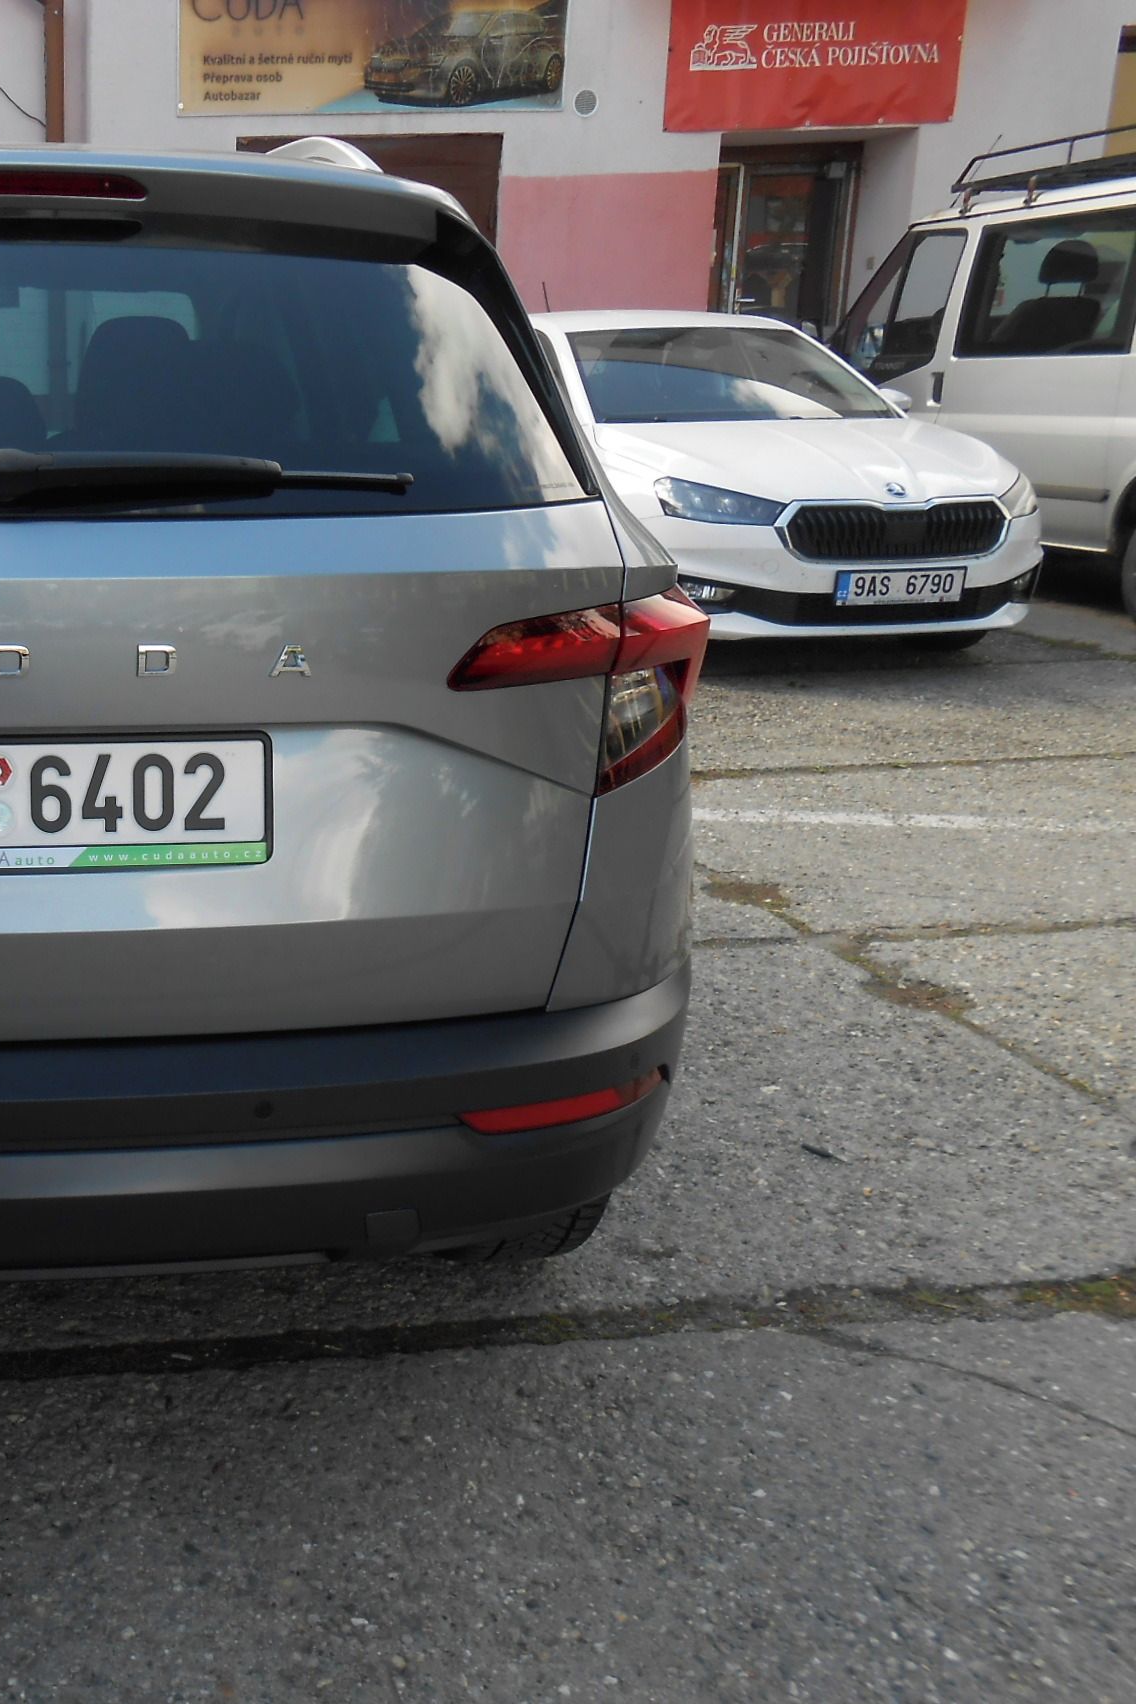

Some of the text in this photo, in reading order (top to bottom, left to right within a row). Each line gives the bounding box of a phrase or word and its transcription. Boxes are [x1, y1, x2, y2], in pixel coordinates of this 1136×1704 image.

[763, 21, 856, 43] GENERALI
[203, 53, 246, 65] Kvalitní
[248, 56, 256, 65] a
[258, 52, 294, 65] šetrné
[296, 52, 325, 65] ruční
[761, 41, 940, 69] ČESKÁ POJIŠŤOVNA
[203, 71, 283, 85] Přeprava osob
[203, 91, 261, 101] Autobazar
[853, 573, 955, 597] 9AS 6790
[837, 590, 848, 598] CZ
[29, 753, 227, 834] 6402
[15, 856, 55, 866] auto
[88, 849, 263, 863] www.cudaauto.cz
